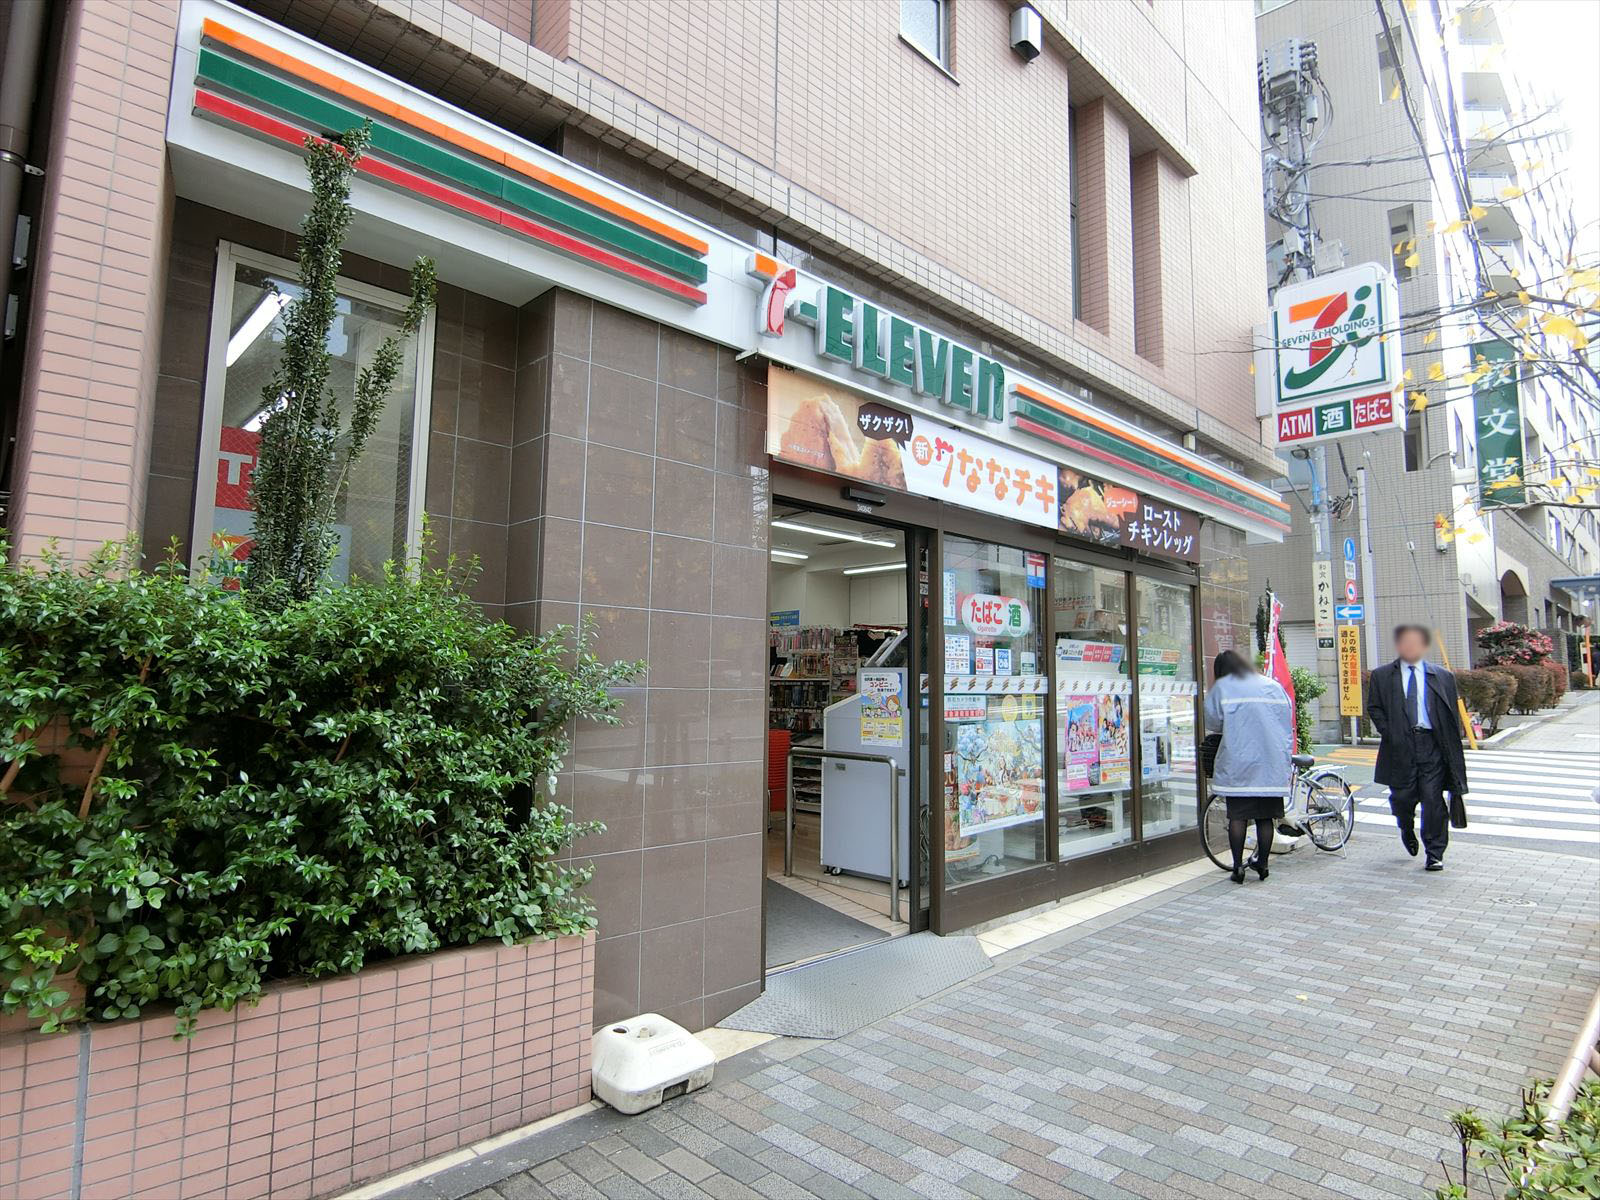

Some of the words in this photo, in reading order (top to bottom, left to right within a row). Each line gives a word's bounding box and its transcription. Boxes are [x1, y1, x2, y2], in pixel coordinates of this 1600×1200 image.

[1324, 316, 1376, 337] HOLDINGS
[859, 414, 910, 434] ザクザク!
[1280, 412, 1311, 438] ATM
[1321, 406, 1345, 432] 酒
[1355, 398, 1391, 425] たばこ
[915, 440, 929, 459] 新
[1143, 504, 1181, 532] ロースト
[1127, 520, 1193, 555] チキンレッグ
[970, 599, 1003, 625] たばこ
[1008, 603, 1022, 627] 酒
[1318, 581, 1330, 620] かねこ
[1340, 630, 1351, 701] 通りぬけできません
